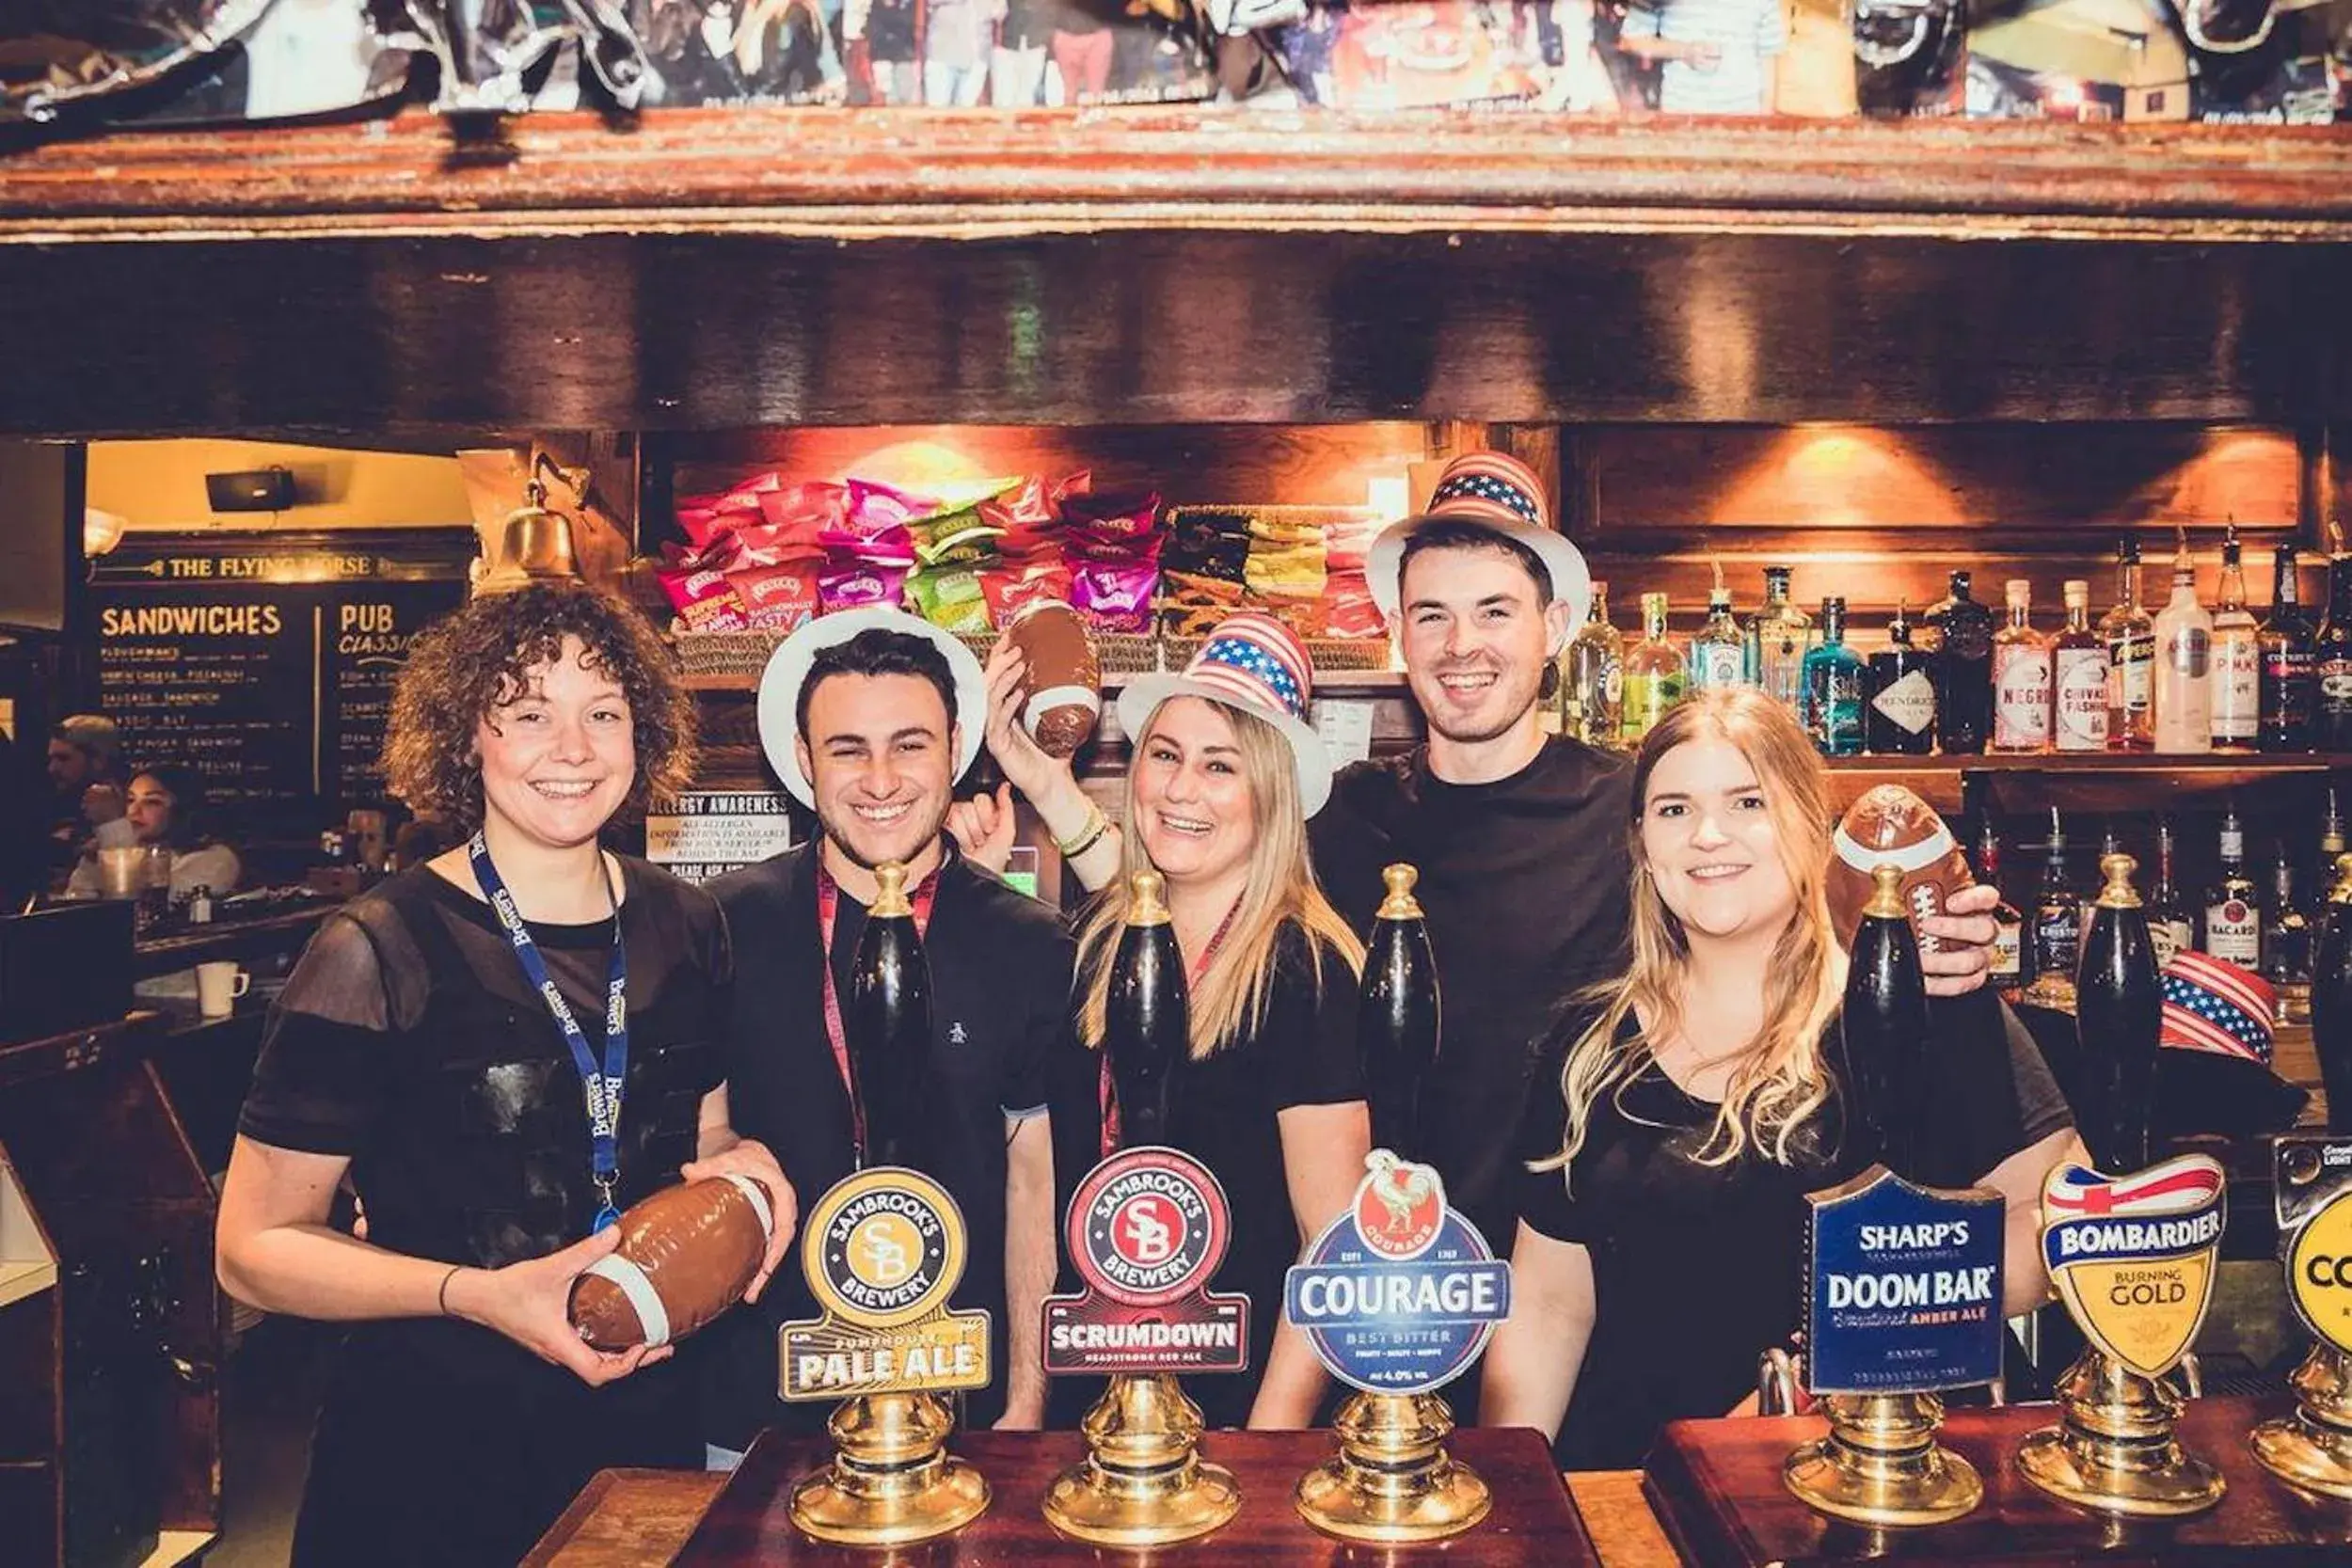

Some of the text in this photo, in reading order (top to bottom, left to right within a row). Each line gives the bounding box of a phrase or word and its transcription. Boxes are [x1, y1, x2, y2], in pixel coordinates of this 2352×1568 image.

[168, 559, 213, 577] THE
[303, 556, 371, 576] ORSE
[102, 604, 281, 637] SANDWICHES
[340, 604, 394, 633] PUB
[708, 795, 787, 814] AWARENESS
[1095, 1173, 1203, 1219] SAMBROOK'S
[831, 1194, 939, 1243] SAMBROOK'S
[2059, 1210, 2220, 1257] BOMBARDIER
[1364, 1224, 1433, 1253] COURAGE
[1859, 1221, 1970, 1252] SHARP'S
[1103, 1252, 1192, 1286] BREWERY
[2114, 1269, 2182, 1283] BURNING
[840, 1271, 931, 1307] BREWERY
[1300, 1272, 1498, 1317] COURAGE
[1828, 1267, 1994, 1309] DOOM BAR
[2109, 1283, 2186, 1306] GOLD
[1910, 1309, 1958, 1325] AMBER
[1961, 1306, 1988, 1322] ALE
[1052, 1323, 1237, 1350] SCRUMDOWN
[1346, 1330, 1451, 1345] BEST BITTER
[799, 1344, 975, 1390] PALE ALE
[1183, 1353, 1202, 1361] ALE
